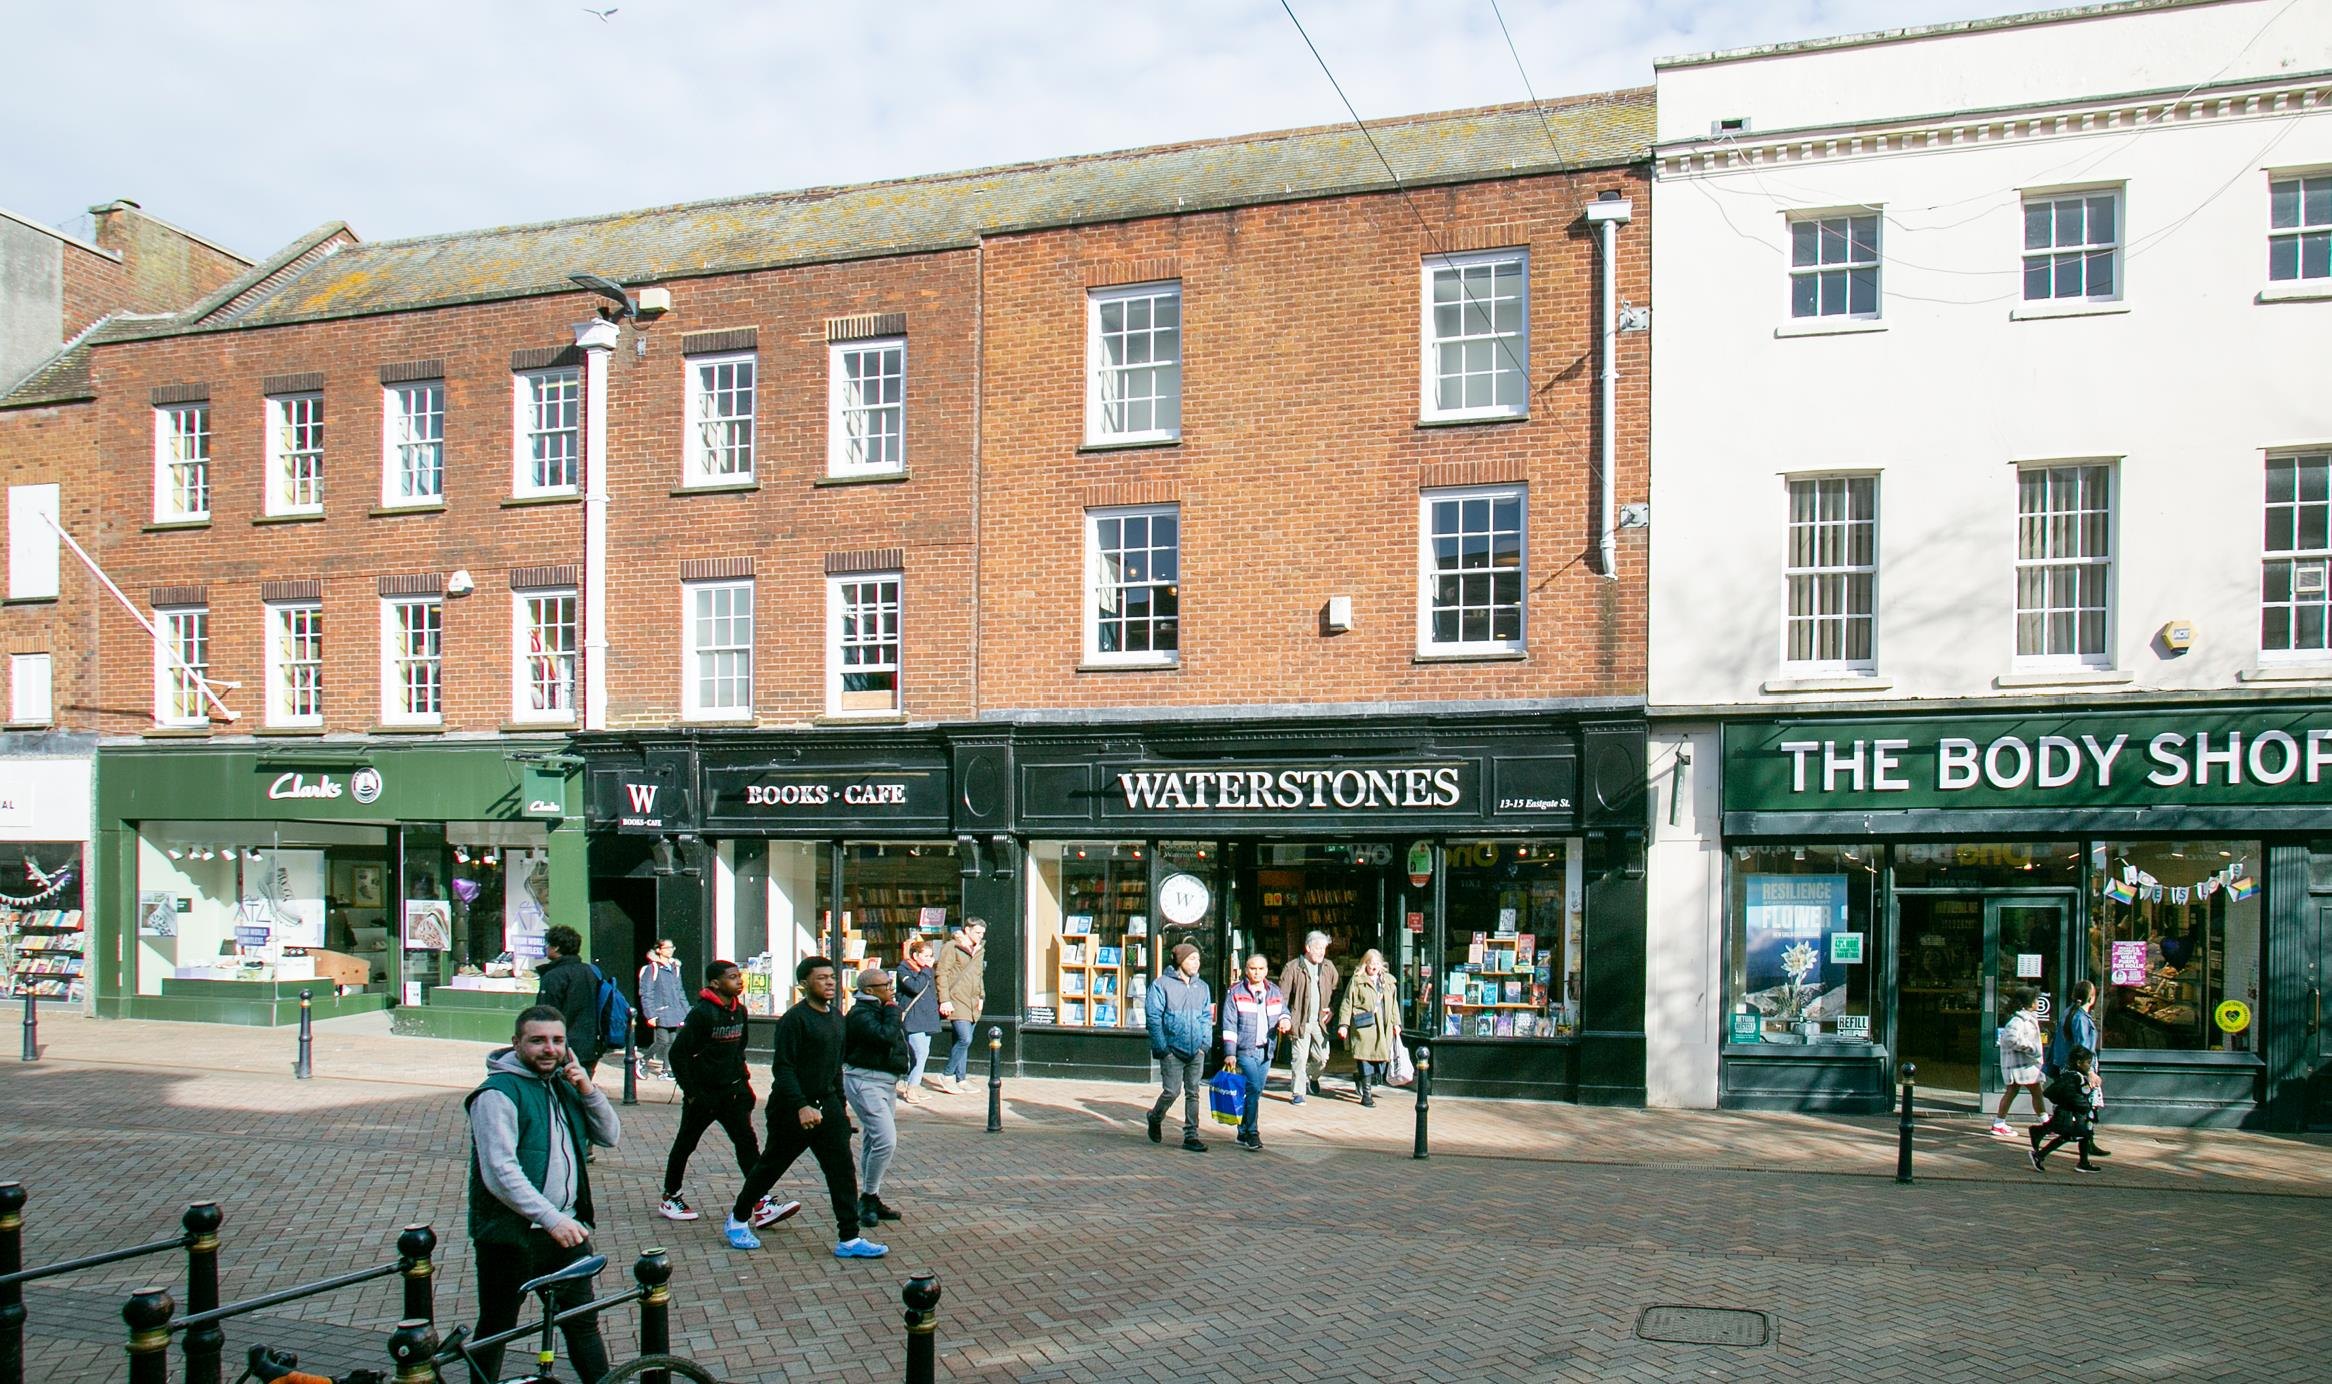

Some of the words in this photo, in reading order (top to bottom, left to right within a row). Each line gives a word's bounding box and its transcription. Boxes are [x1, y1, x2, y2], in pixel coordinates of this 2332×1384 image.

[1781, 738, 1910, 792] THE
[1939, 733, 2130, 790] BODY
[268, 772, 343, 800] Clarks
[746, 785, 829, 805] BOOKS
[844, 784, 906, 805] CAFE
[1117, 768, 1461, 809] WATERSTONES
[529, 800, 560, 812] Clarks
[625, 783, 659, 815] W
[1500, 799, 1525, 808] 13-15
[1525, 799, 1559, 810] Eastgate
[1559, 798, 1571, 808] St.
[1763, 883, 1831, 899] RESILIENCE
[1762, 906, 1831, 928] FLOWER
[1838, 1016, 1868, 1029] REFILL
